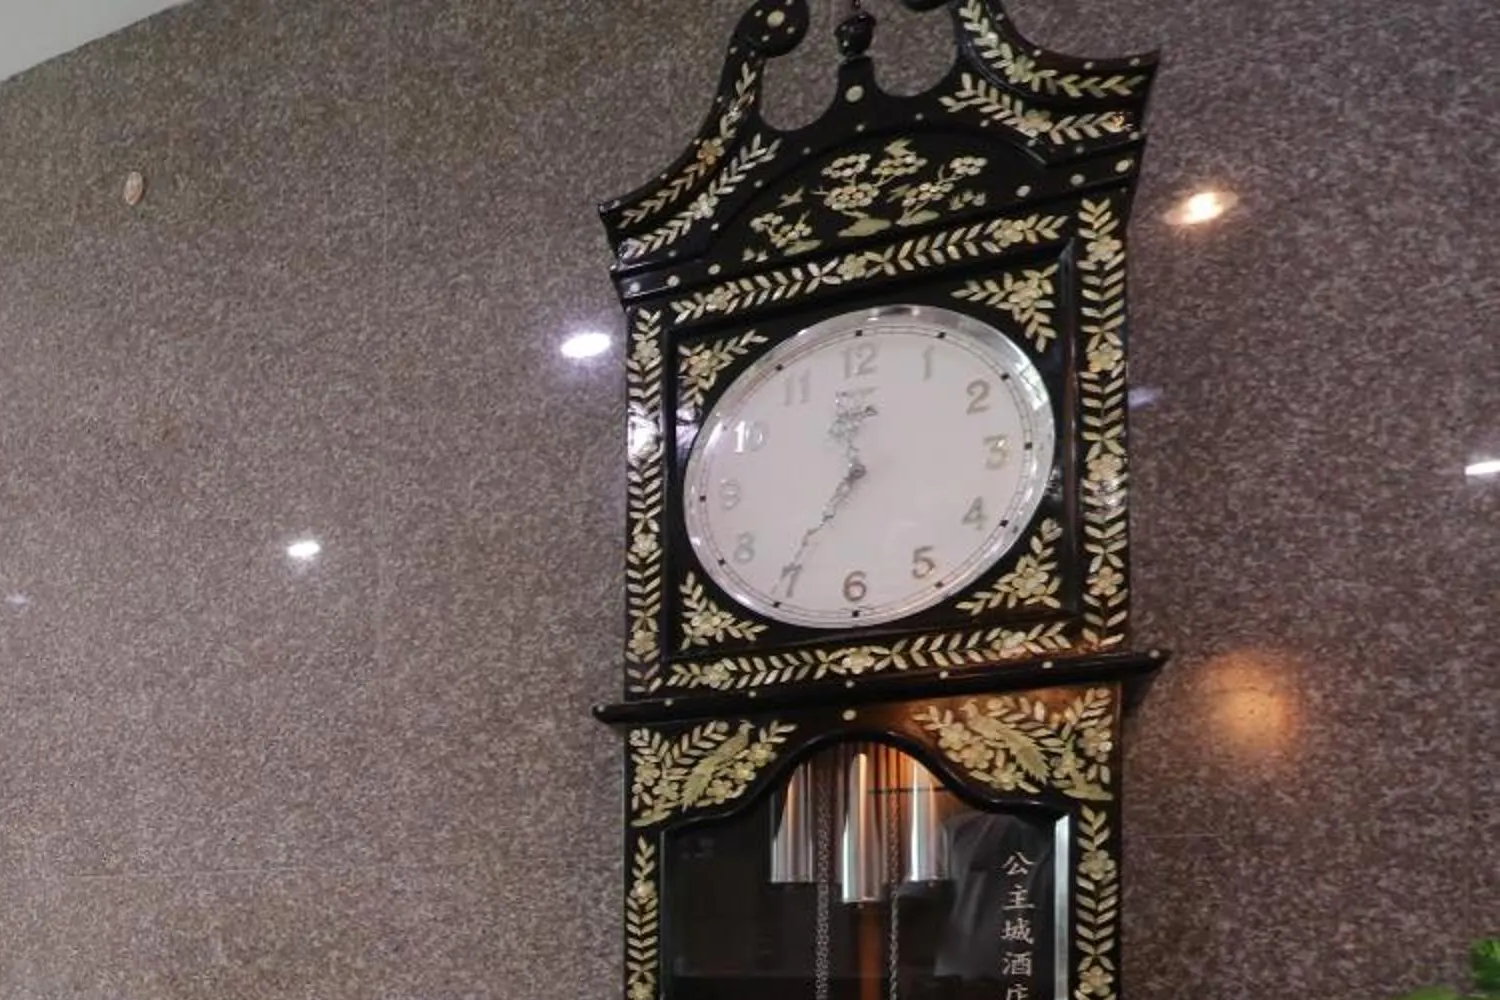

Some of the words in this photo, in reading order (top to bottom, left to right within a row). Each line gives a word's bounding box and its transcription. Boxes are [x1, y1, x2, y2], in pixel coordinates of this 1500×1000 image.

[841, 343, 879, 379] 12
[922, 344, 935, 381] 1
[784, 368, 812, 407] 11
[965, 378, 991, 416] 2
[733, 420, 769, 454] 10
[983, 434, 1010, 471] 3
[961, 495, 988, 530] 4
[733, 530, 756, 564] 8
[911, 546, 936, 582] 5
[842, 570, 868, 602] 6
